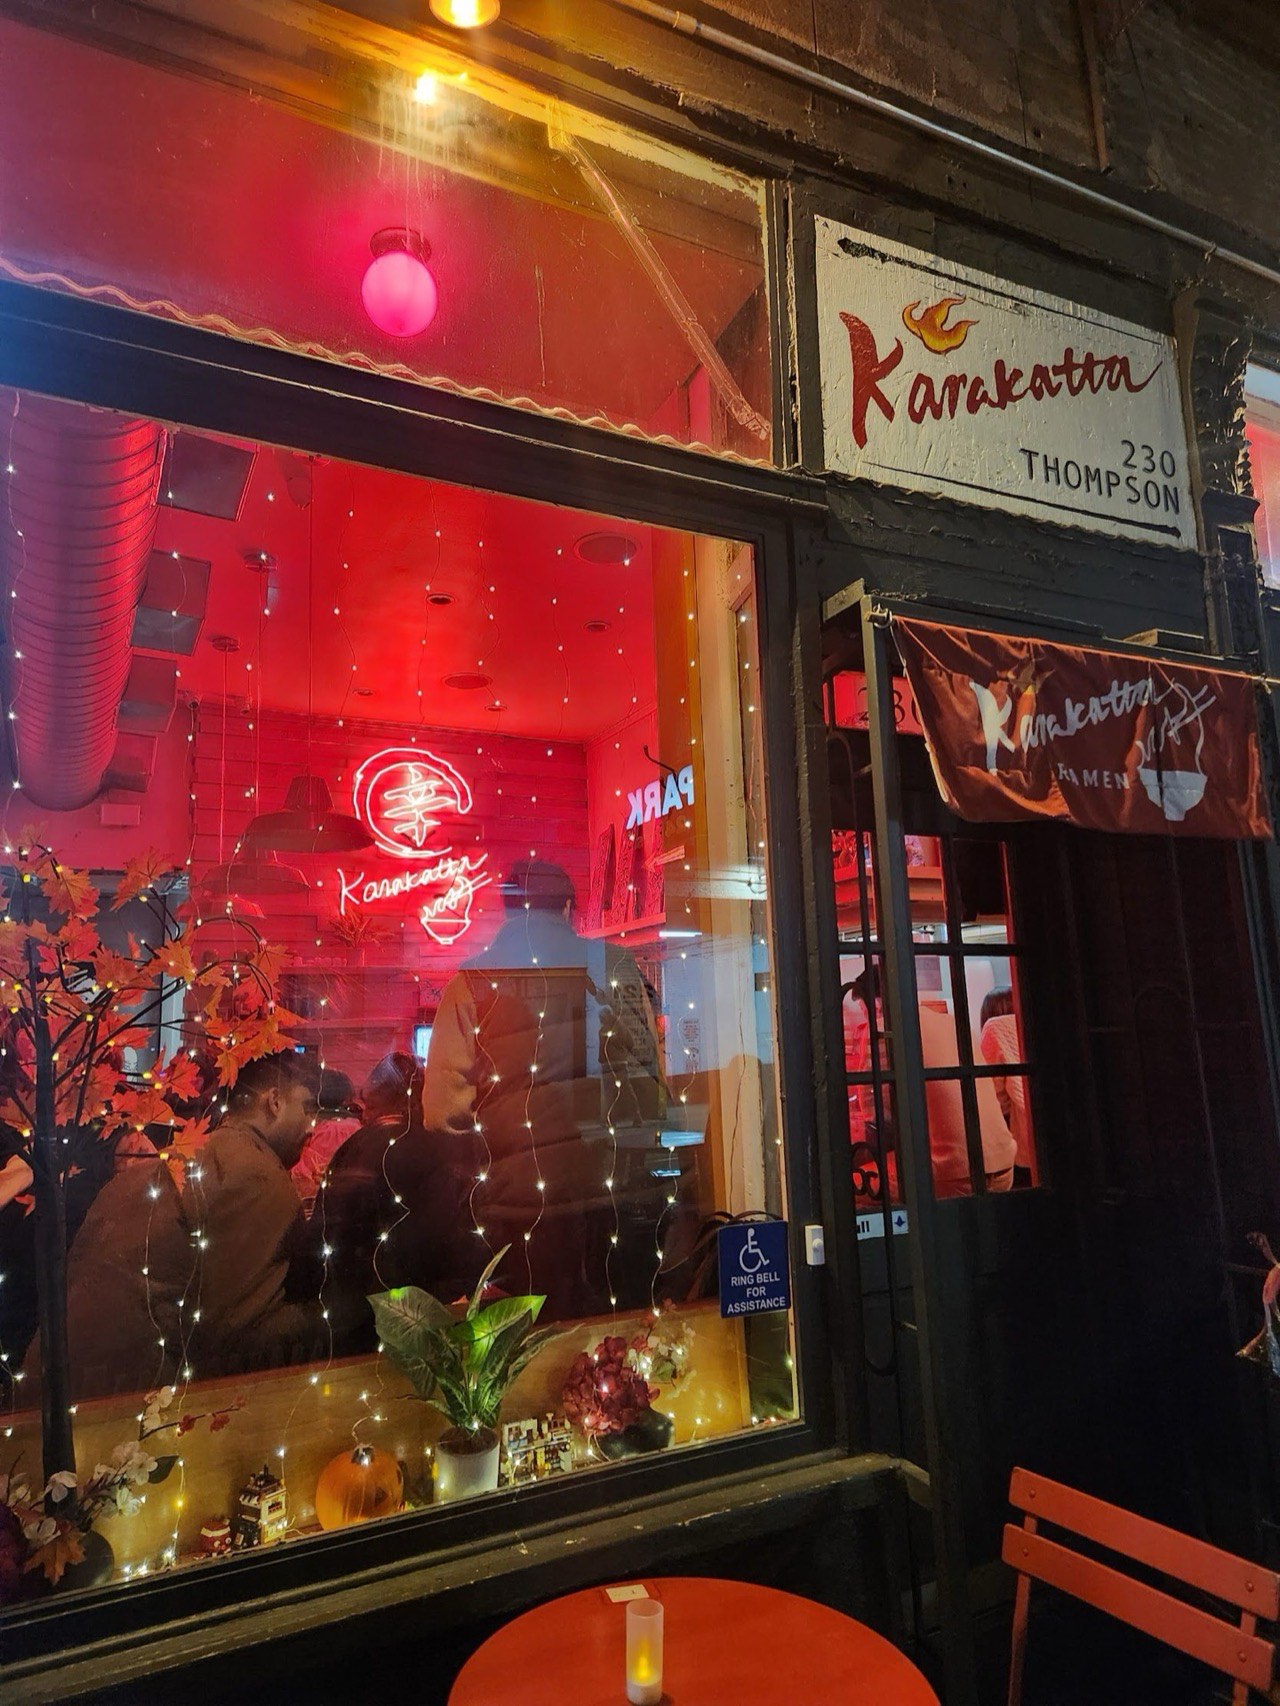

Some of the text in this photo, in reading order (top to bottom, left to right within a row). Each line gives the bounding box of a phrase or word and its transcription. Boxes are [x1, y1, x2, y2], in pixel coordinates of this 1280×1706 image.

[838, 311, 1163, 450] Karakatta
[1120, 439, 1176, 479] 230
[1018, 447, 1181, 515] THOMPSON
[731, 1271, 781, 1287] RING BELL
[746, 1286, 767, 1298] FOR
[727, 1296, 786, 1314] ASSISTANCE
